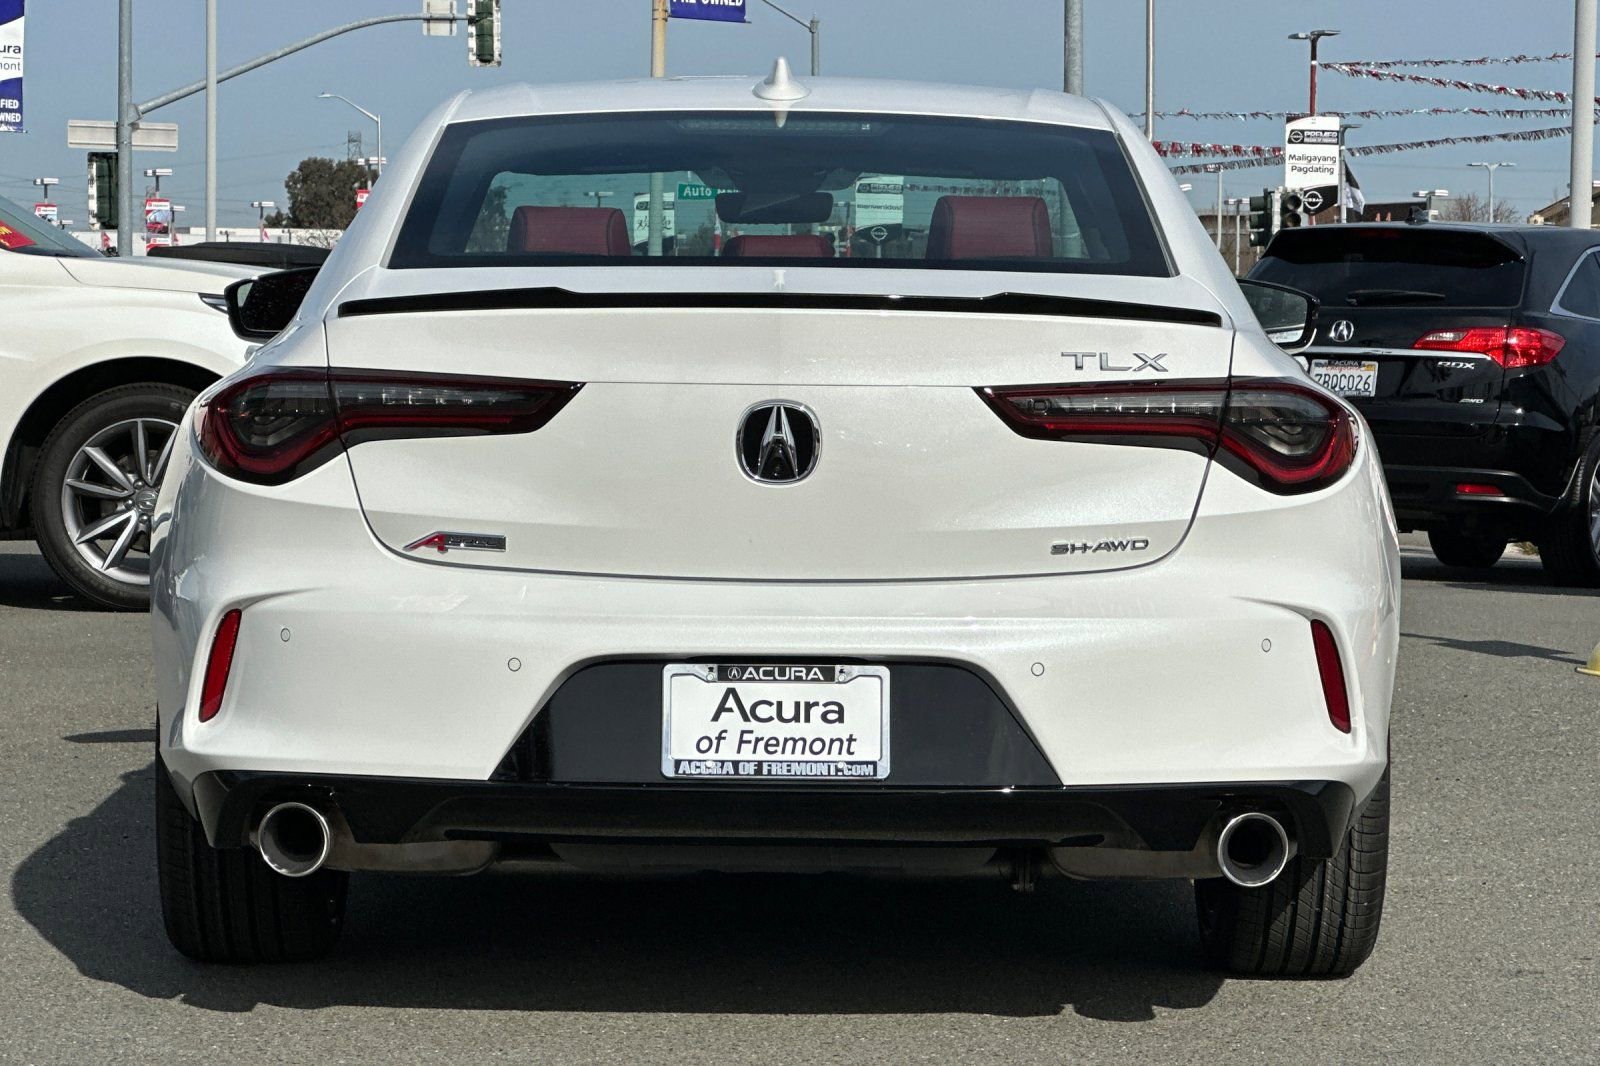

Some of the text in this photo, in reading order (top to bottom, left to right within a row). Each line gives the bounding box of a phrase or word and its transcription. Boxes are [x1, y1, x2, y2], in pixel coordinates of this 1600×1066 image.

[1288, 154, 1337, 163] Maligayang
[1291, 165, 1335, 175] Pagdating
[683, 186, 712, 197] Auto
[1061, 351, 1169, 372] TLX
[1437, 361, 1475, 370] RDX
[742, 666, 824, 681] ACURA
[710, 687, 845, 724] Acura
[695, 729, 857, 756] of Fremont
[738, 761, 758, 775] OF
